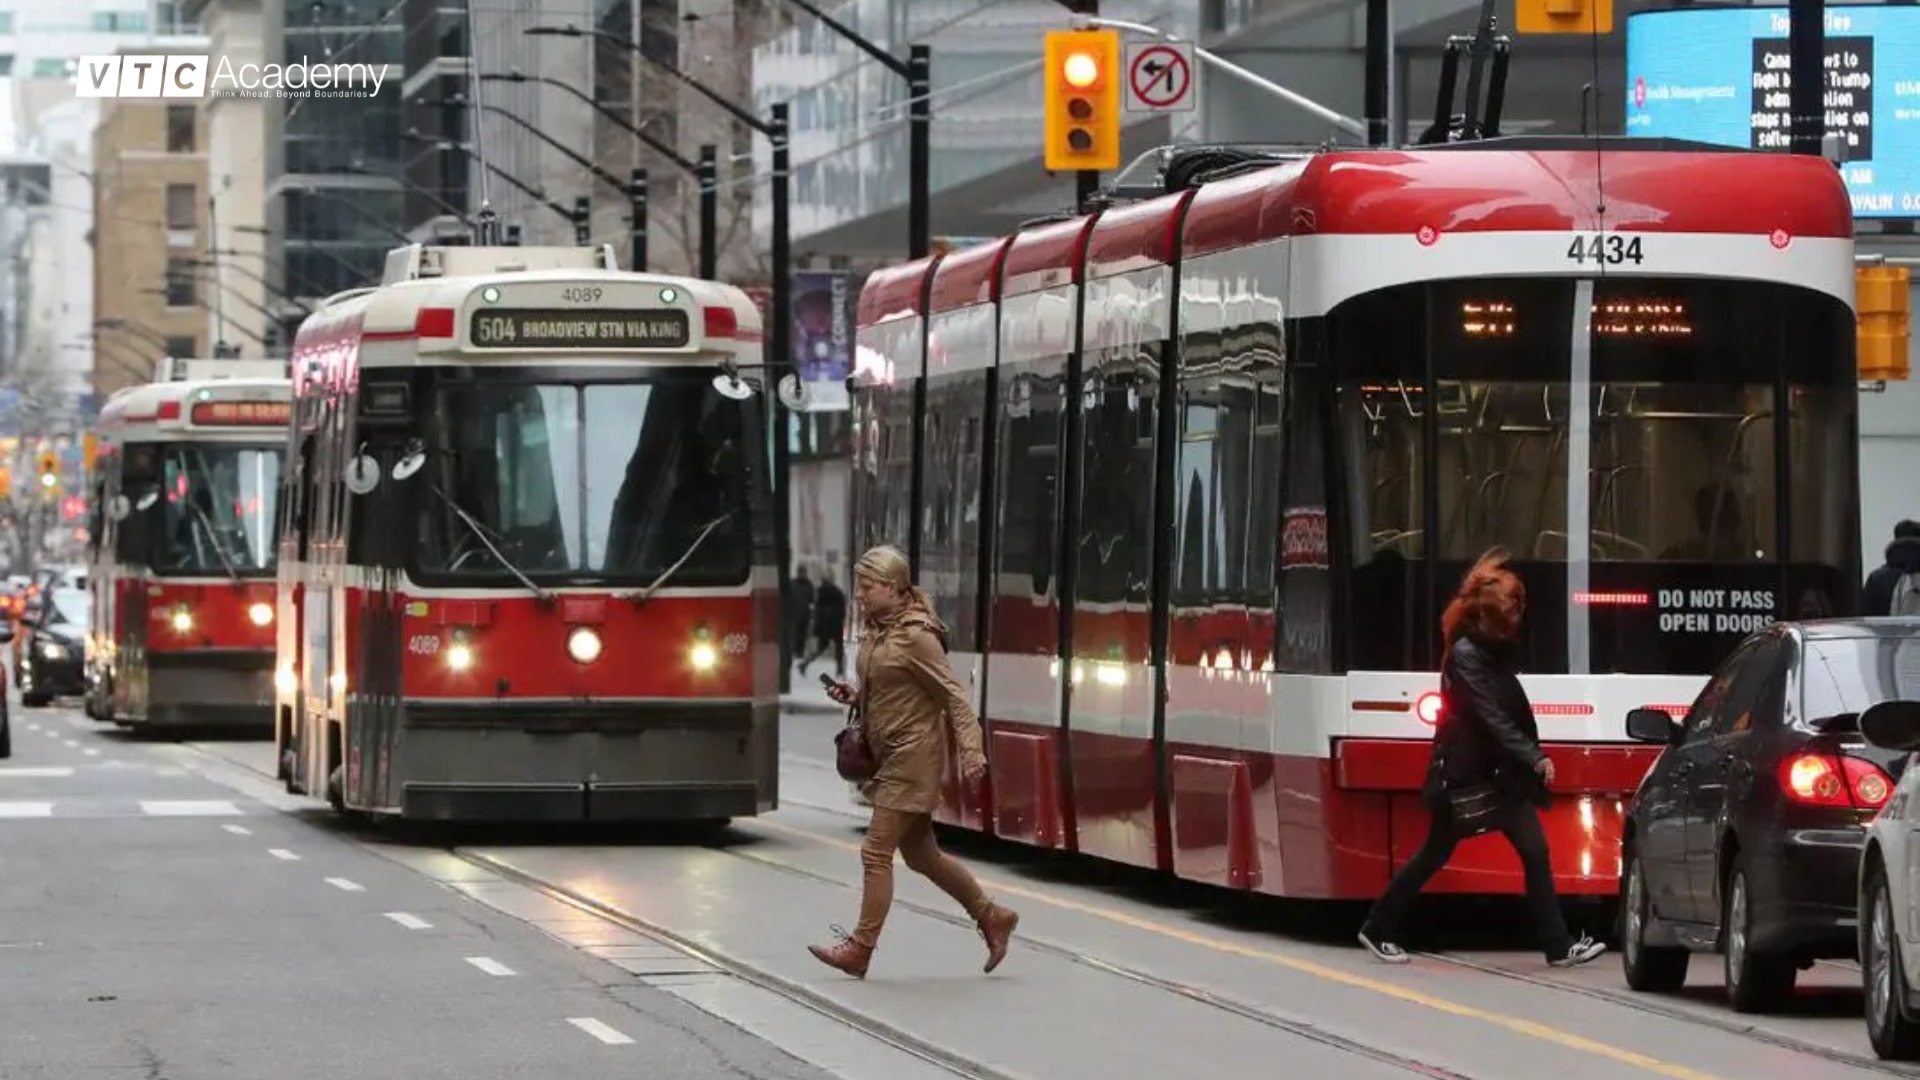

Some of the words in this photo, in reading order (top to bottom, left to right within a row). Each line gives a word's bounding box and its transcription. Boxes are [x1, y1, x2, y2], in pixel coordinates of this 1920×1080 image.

[1829, 71, 1871, 90] Trump
[1852, 111, 1870, 127] on
[1567, 235, 1643, 265] 4434
[562, 287, 603, 302] 4089
[478, 317, 517, 342] 504
[522, 321, 597, 338] BROADVIEW
[600, 321, 625, 338] STN
[627, 321, 648, 338] VIA
[650, 321, 680, 338] KING
[1658, 589, 1684, 608] DO
[1690, 589, 1725, 608] NOT
[1730, 590, 1775, 609] PASS
[1660, 613, 1709, 632] OPEN
[409, 635, 440, 655] 4089
